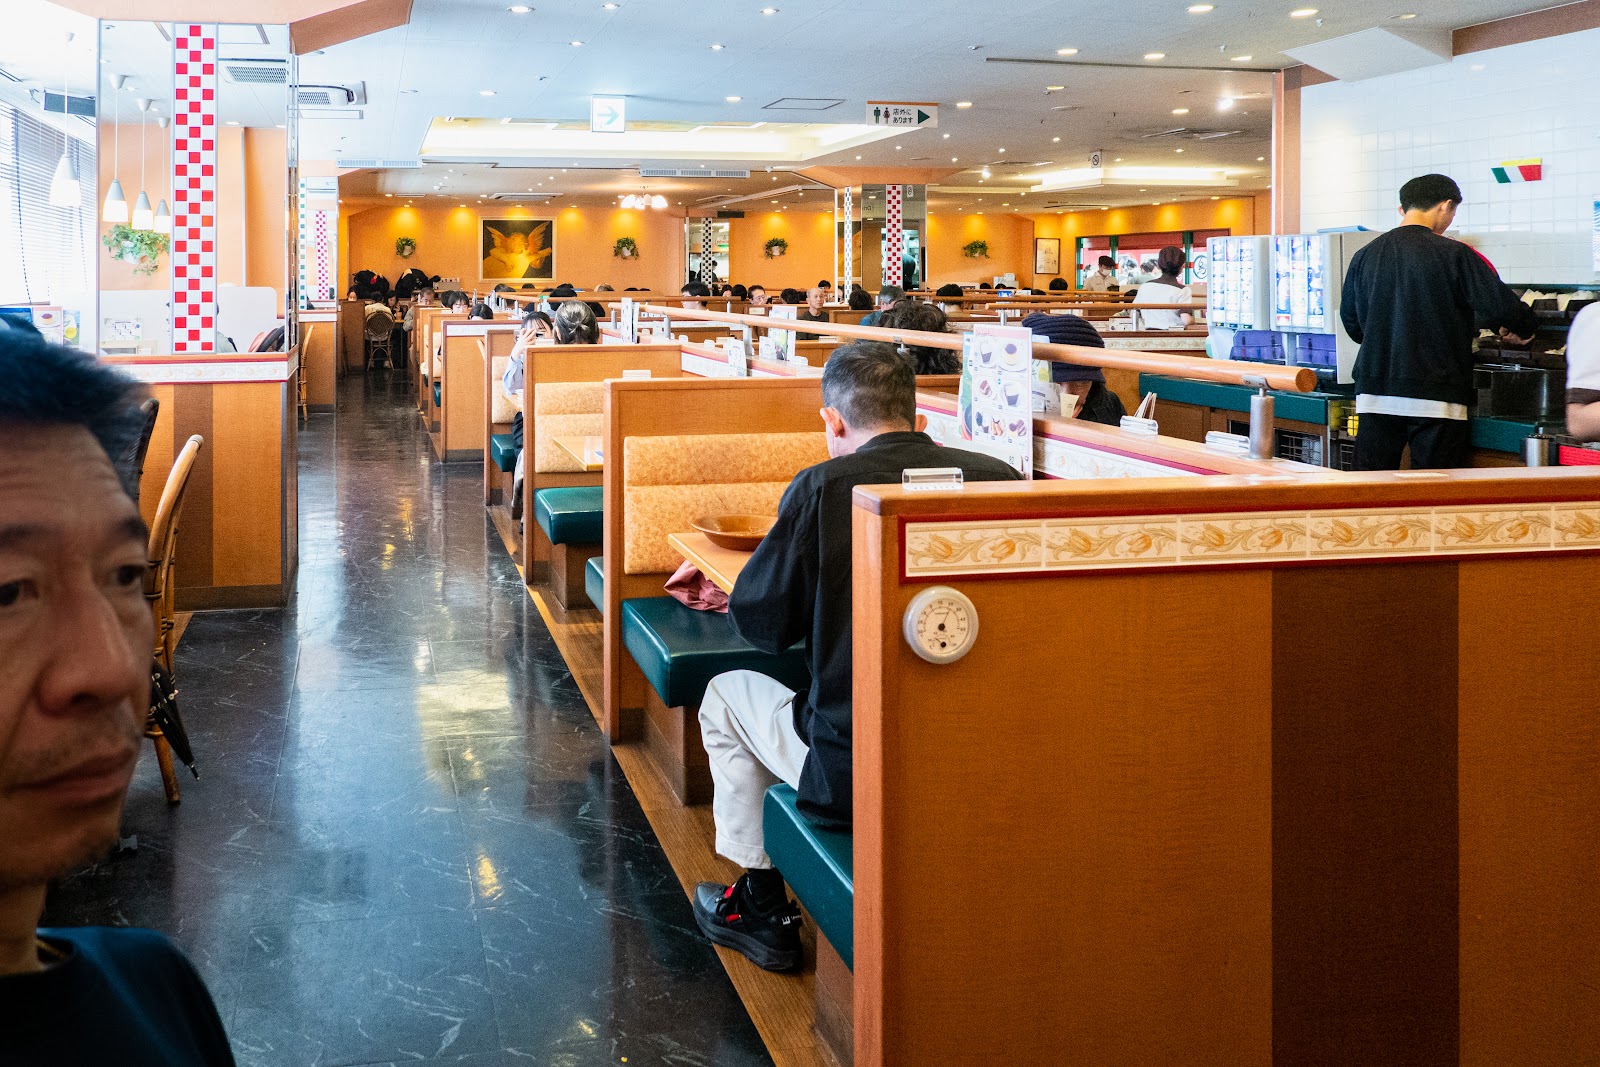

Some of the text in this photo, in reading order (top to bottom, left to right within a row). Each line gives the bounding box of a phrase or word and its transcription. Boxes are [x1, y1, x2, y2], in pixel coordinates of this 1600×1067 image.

[893, 108, 912, 116] 店外に
[893, 116, 913, 124] あります
